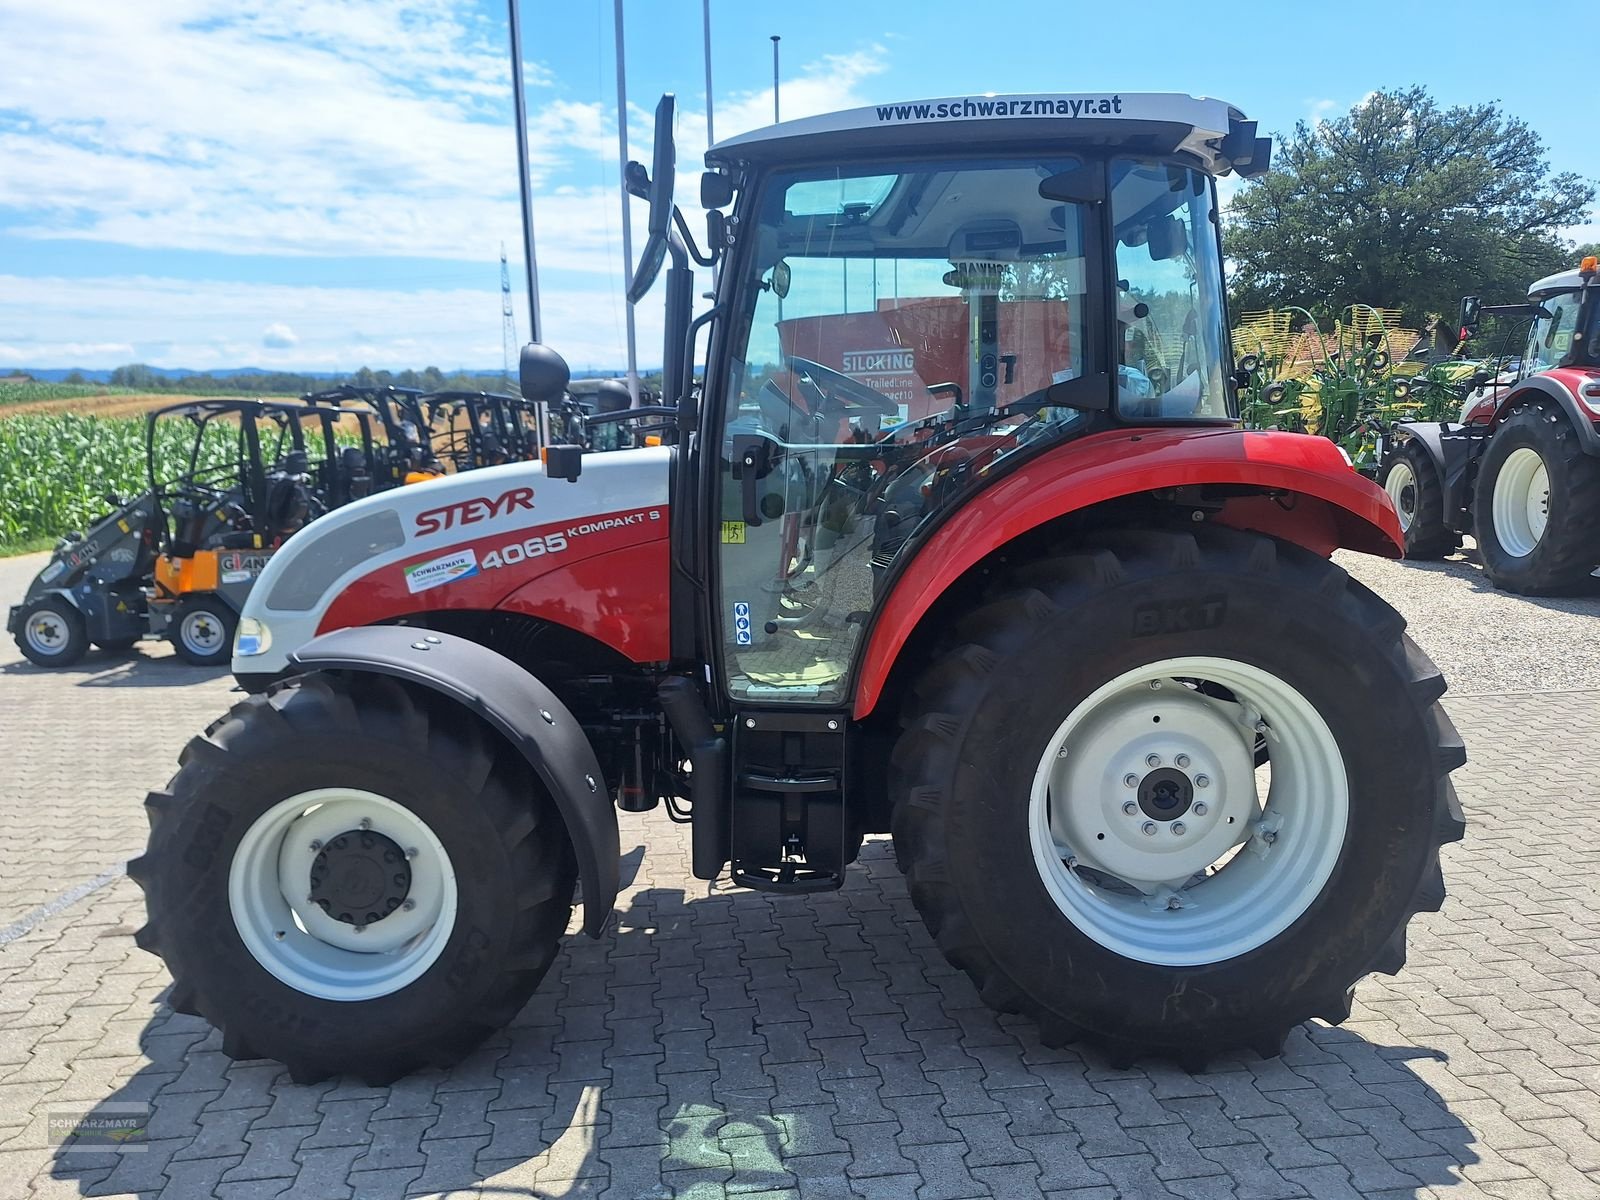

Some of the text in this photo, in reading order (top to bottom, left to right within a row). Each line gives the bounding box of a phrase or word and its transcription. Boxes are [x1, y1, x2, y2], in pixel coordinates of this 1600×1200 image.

[876, 95, 1122, 119] www.schwarzmayr.at
[843, 354, 914, 371] SILOKING
[414, 487, 535, 538] STEYR
[481, 510, 661, 570] 4065 KOMPAKT S
[412, 558, 466, 578] SCHWARZMAYR
[1136, 600, 1224, 633] BKT
